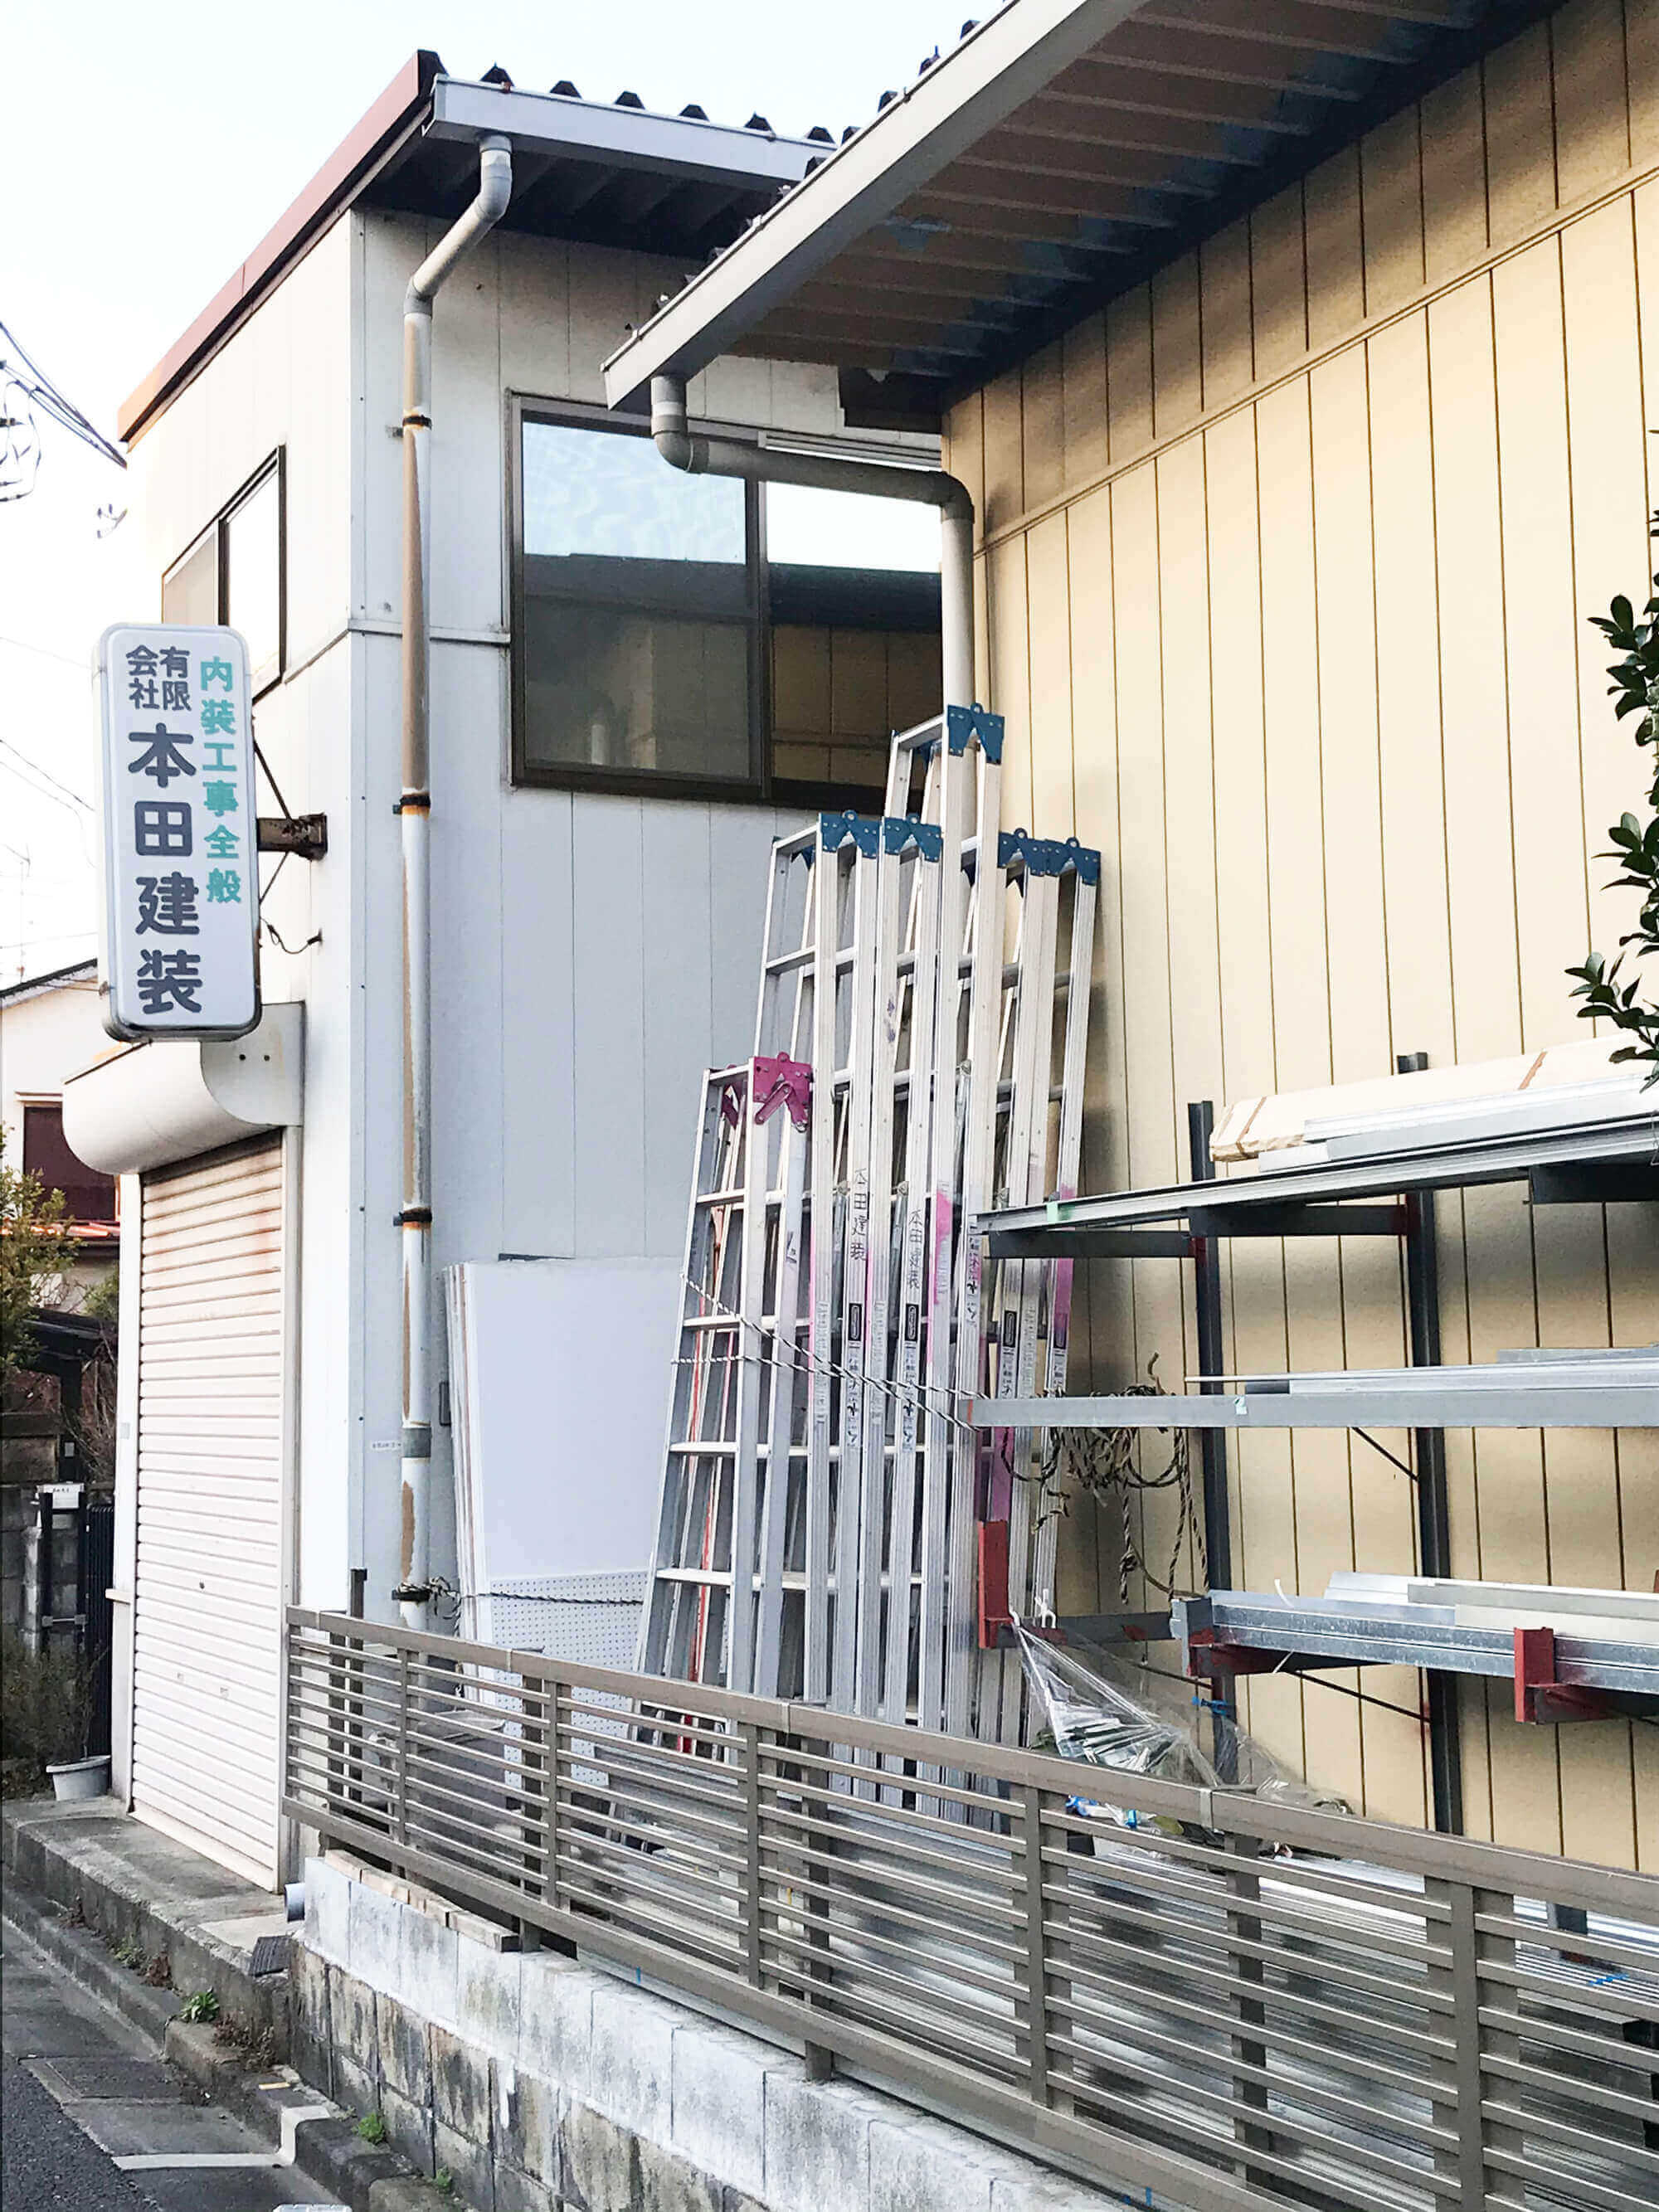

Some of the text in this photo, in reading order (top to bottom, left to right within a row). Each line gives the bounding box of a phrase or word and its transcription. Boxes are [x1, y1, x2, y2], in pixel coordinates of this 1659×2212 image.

[128, 722, 202, 1015] 本田建装
[200, 656, 242, 903] 内装工事全般
